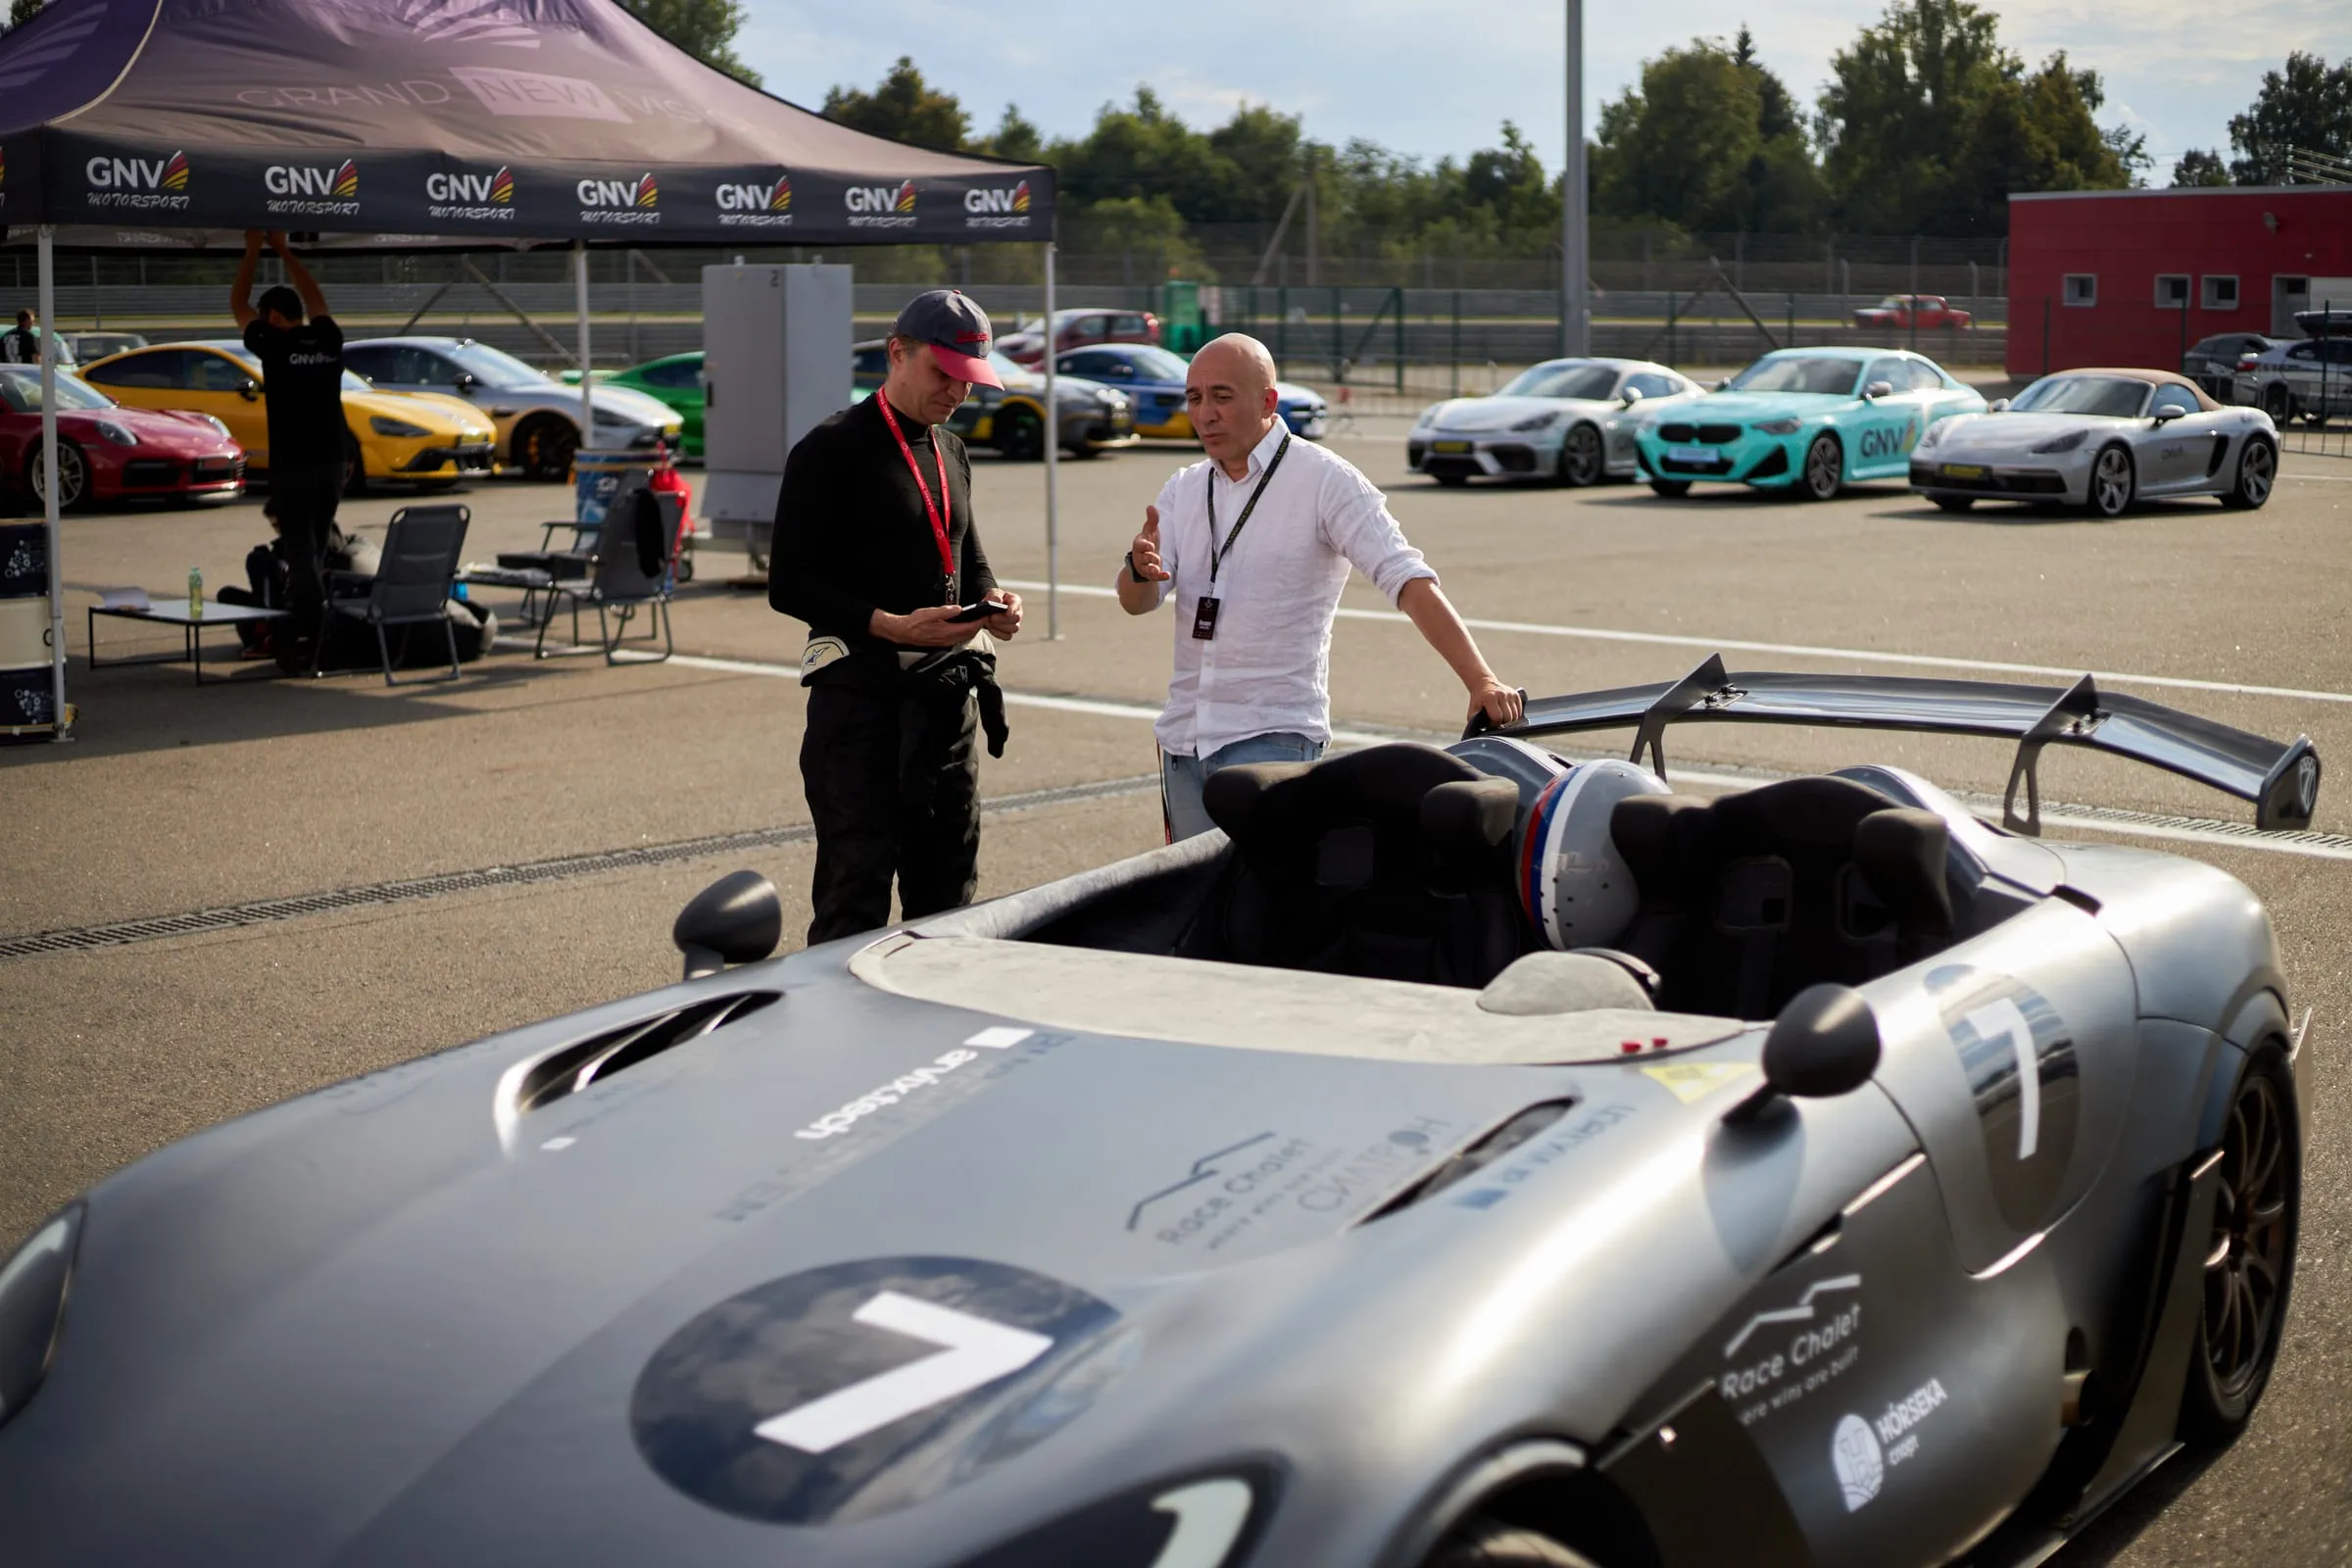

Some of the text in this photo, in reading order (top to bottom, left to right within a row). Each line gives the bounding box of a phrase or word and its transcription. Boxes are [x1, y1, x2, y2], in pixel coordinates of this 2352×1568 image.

[235, 79, 451, 109] GRAND
[471, 76, 602, 109] NEW
[86, 157, 166, 189] GNV
[265, 166, 336, 196] GNV
[426, 172, 493, 203] GNV
[87, 192, 190, 210] MOTORSPORT
[267, 199, 360, 216] MOTORSPORT
[577, 179, 639, 207] GNV
[716, 183, 772, 211] GNV
[845, 186, 900, 213] GNV
[964, 188, 1015, 213] GNV
[428, 205, 514, 220] MOTORSPORT
[1862, 427, 1906, 458] GNV
[1965, 998, 2039, 1160] 7
[1721, 1302, 1861, 1399] Race Chalet
[754, 1291, 1054, 1454] 7
[1771, 1385, 1803, 1408] wins
[1805, 1369, 1829, 1392] are
[1830, 1346, 1859, 1376] built
